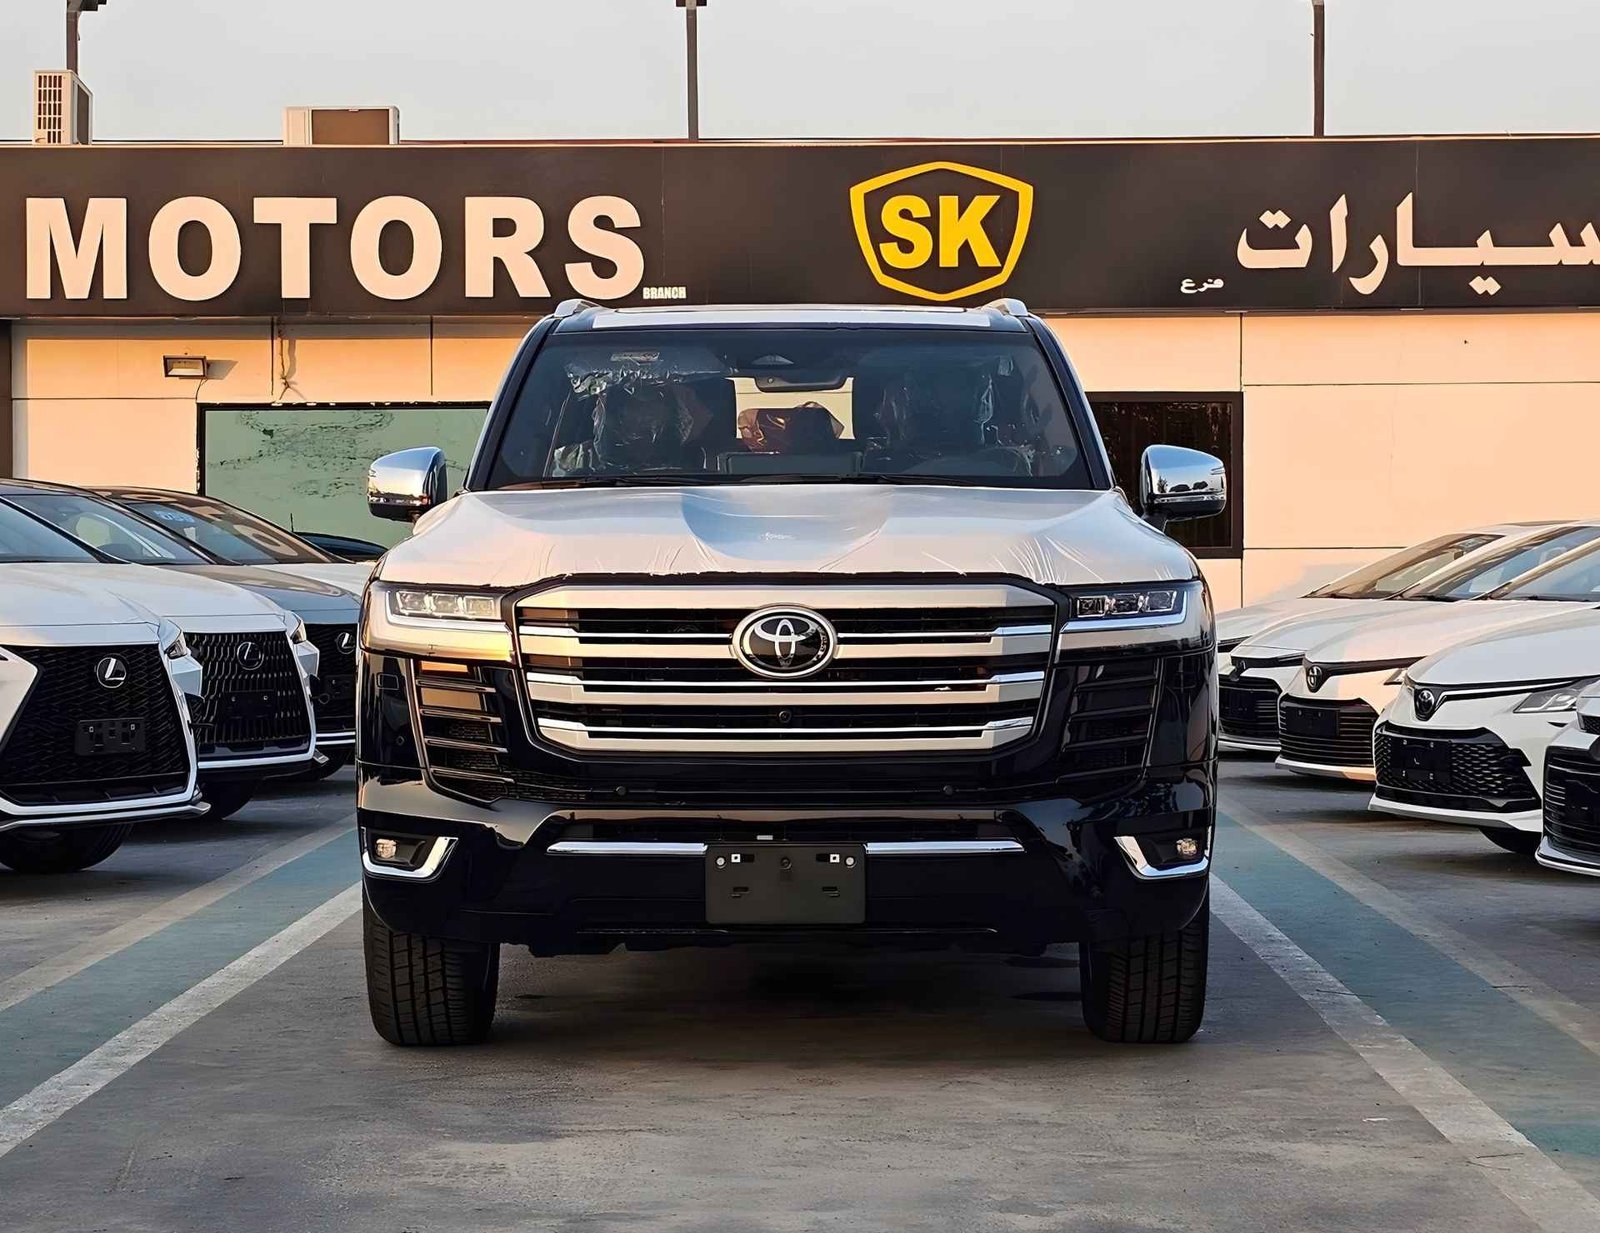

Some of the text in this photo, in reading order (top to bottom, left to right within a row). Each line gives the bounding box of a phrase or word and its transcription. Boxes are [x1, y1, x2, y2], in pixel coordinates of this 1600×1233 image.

[25, 195, 645, 302] MOTORS
[878, 193, 1002, 270] SK
[642, 286, 687, 300] BRANCH
[1180, 278, 1224, 294] فرع
